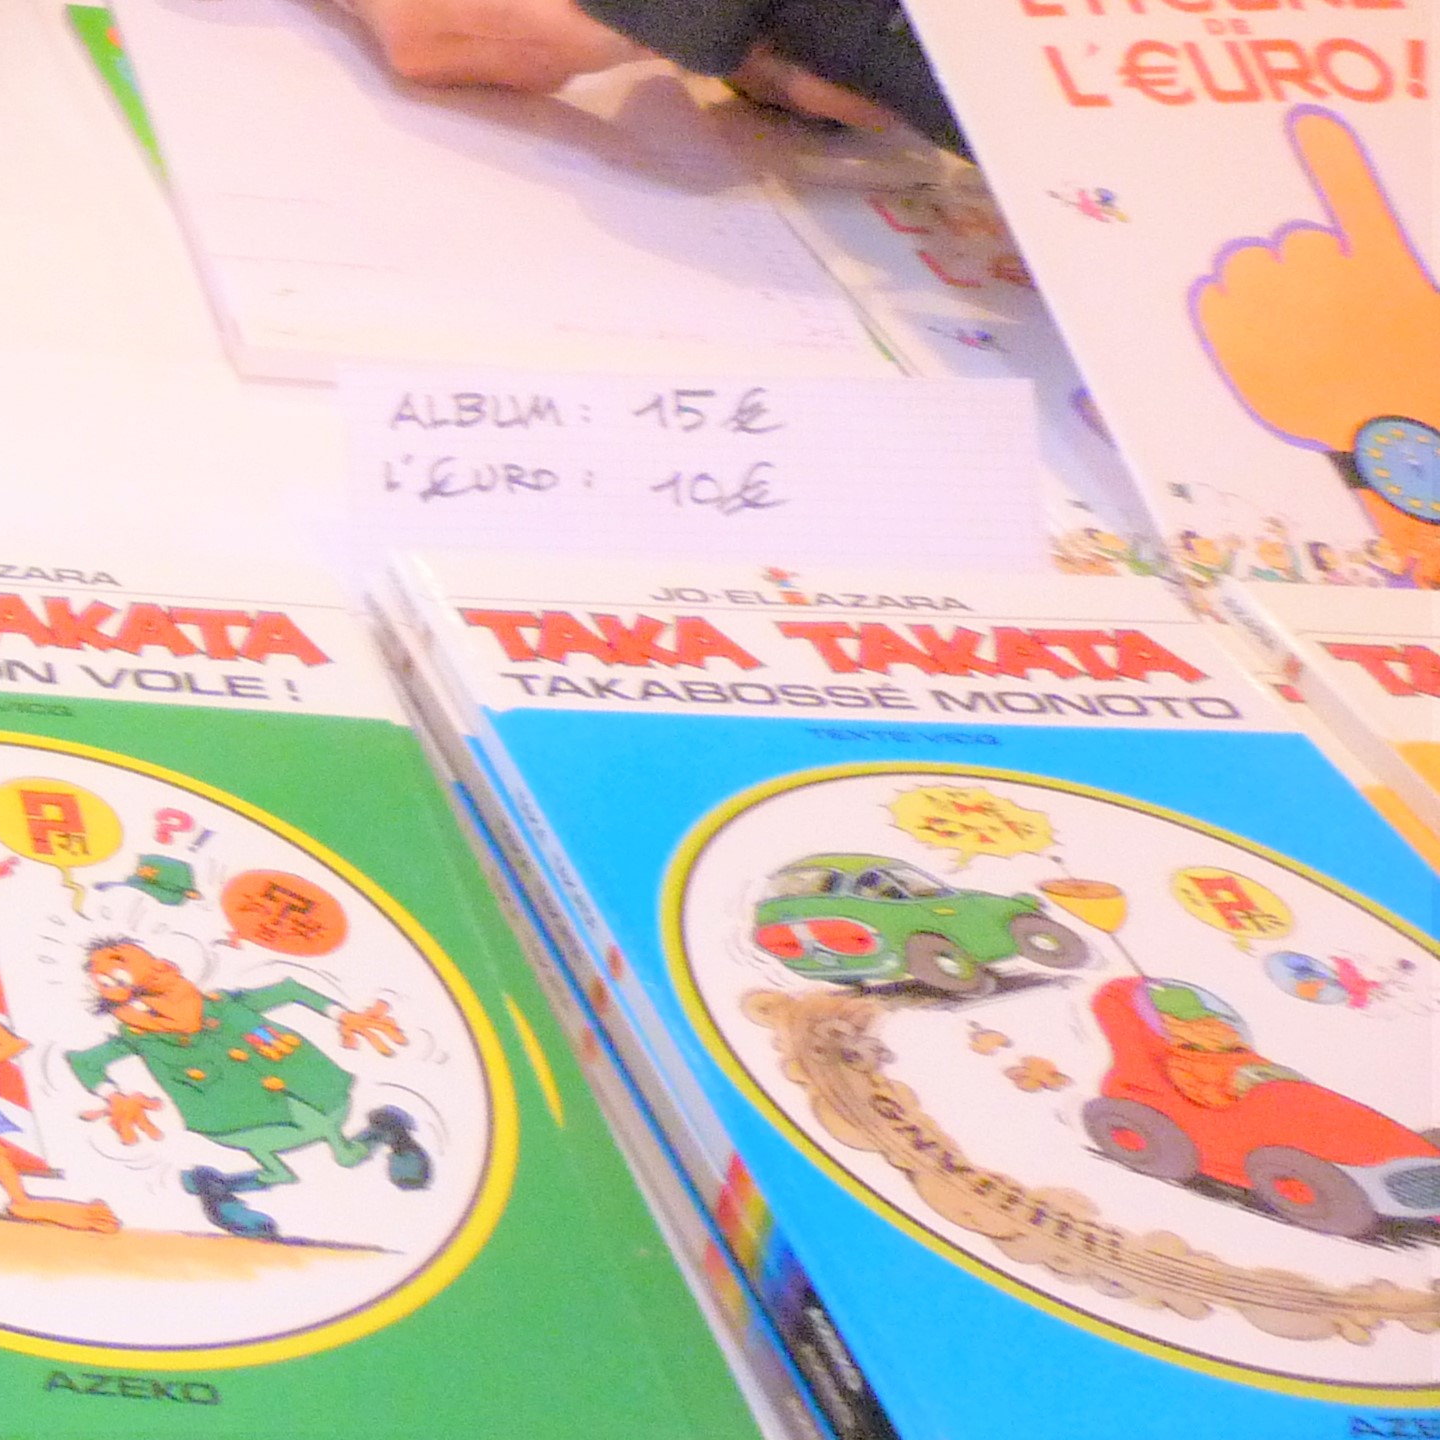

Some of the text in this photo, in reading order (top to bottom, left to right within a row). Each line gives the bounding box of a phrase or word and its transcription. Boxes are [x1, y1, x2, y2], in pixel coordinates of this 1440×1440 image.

[1202, 18, 1252, 35] DE
[811, 592, 974, 611] AZARA
[458, 608, 768, 672] TAKA
[774, 620, 1212, 684] TAKATA
[500, 672, 1243, 720] TAKABOSSÉ MONOTO
[43, 1371, 223, 1406] AZEKO
